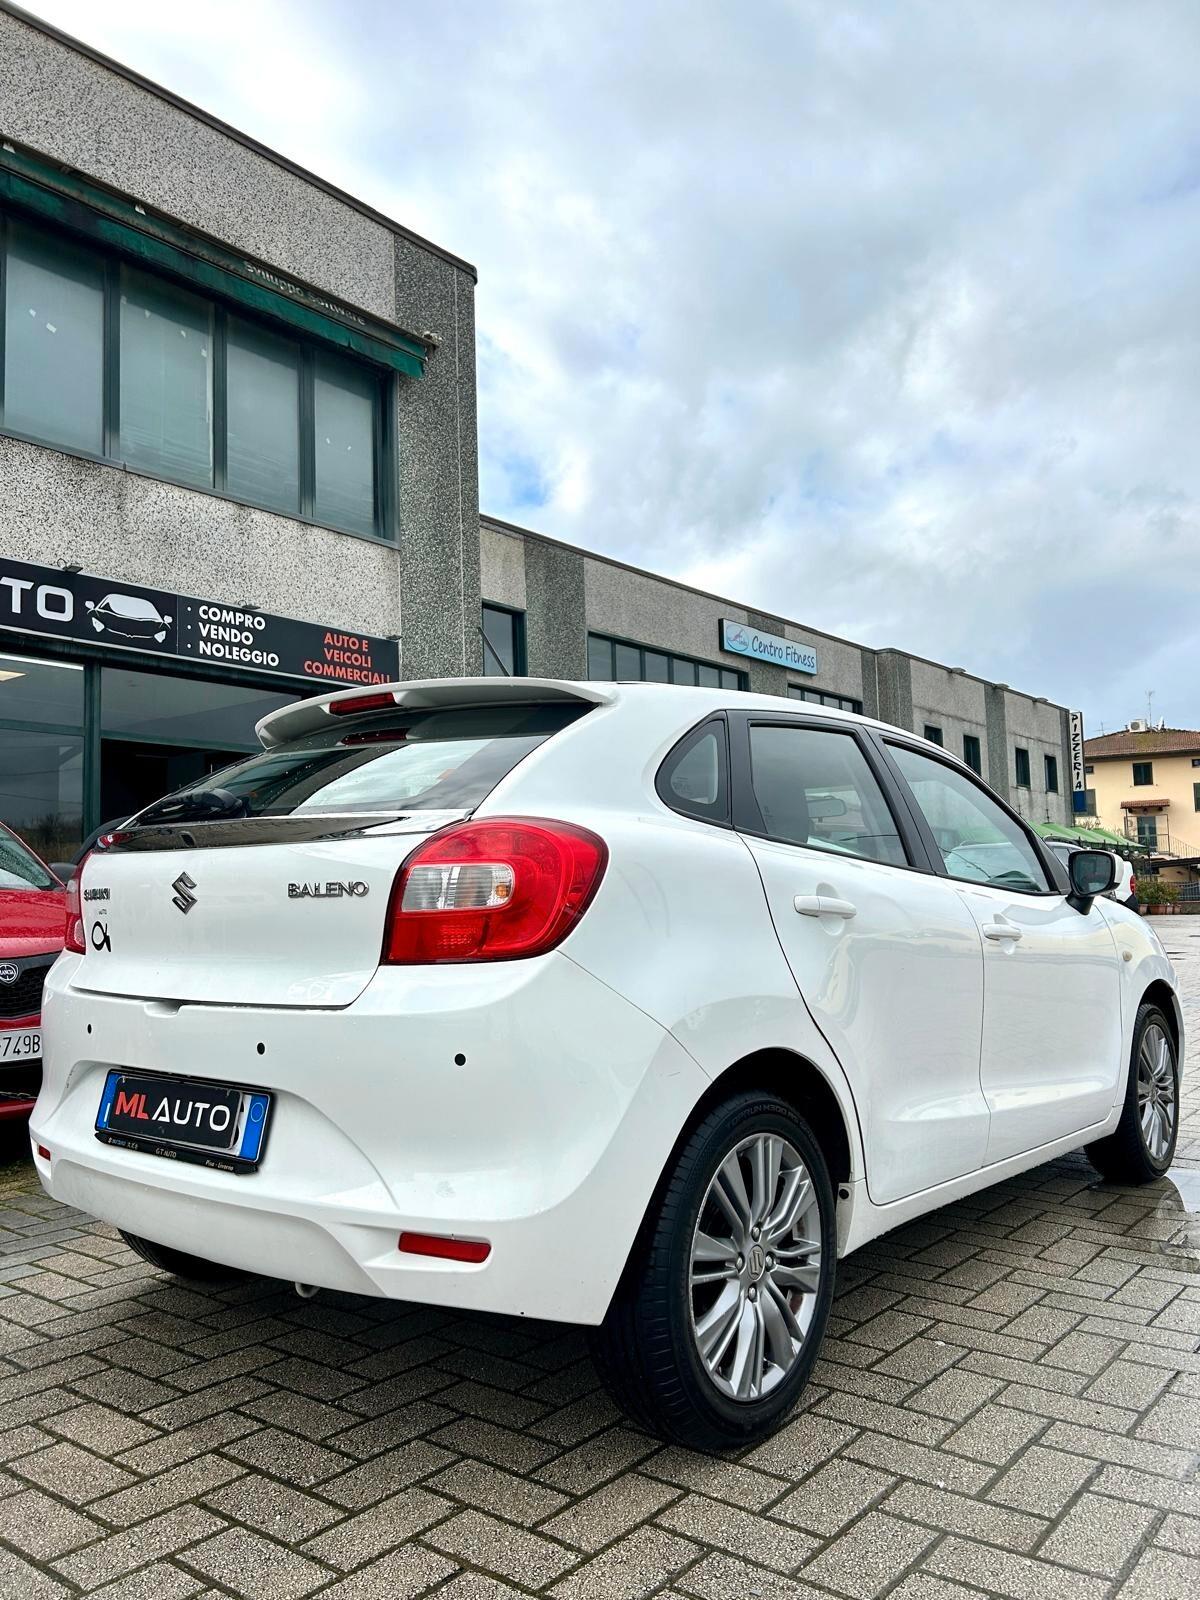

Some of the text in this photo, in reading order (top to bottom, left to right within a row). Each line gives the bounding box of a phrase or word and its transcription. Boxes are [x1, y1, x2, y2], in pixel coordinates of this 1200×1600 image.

[199, 605, 266, 631] COMPRO
[199, 623, 254, 646] VENDO
[323, 632, 369, 652] AUTO E
[199, 640, 280, 667] NOLEGGIO
[323, 647, 372, 668] VEICOLI
[751, 635, 815, 668] Centro Fitness
[1071, 714, 1082, 790] PIZZERIA
[84, 887, 110, 902] SUZUKI
[287, 881, 370, 898] BALENO
[152, 1096, 231, 1131] AUTO
